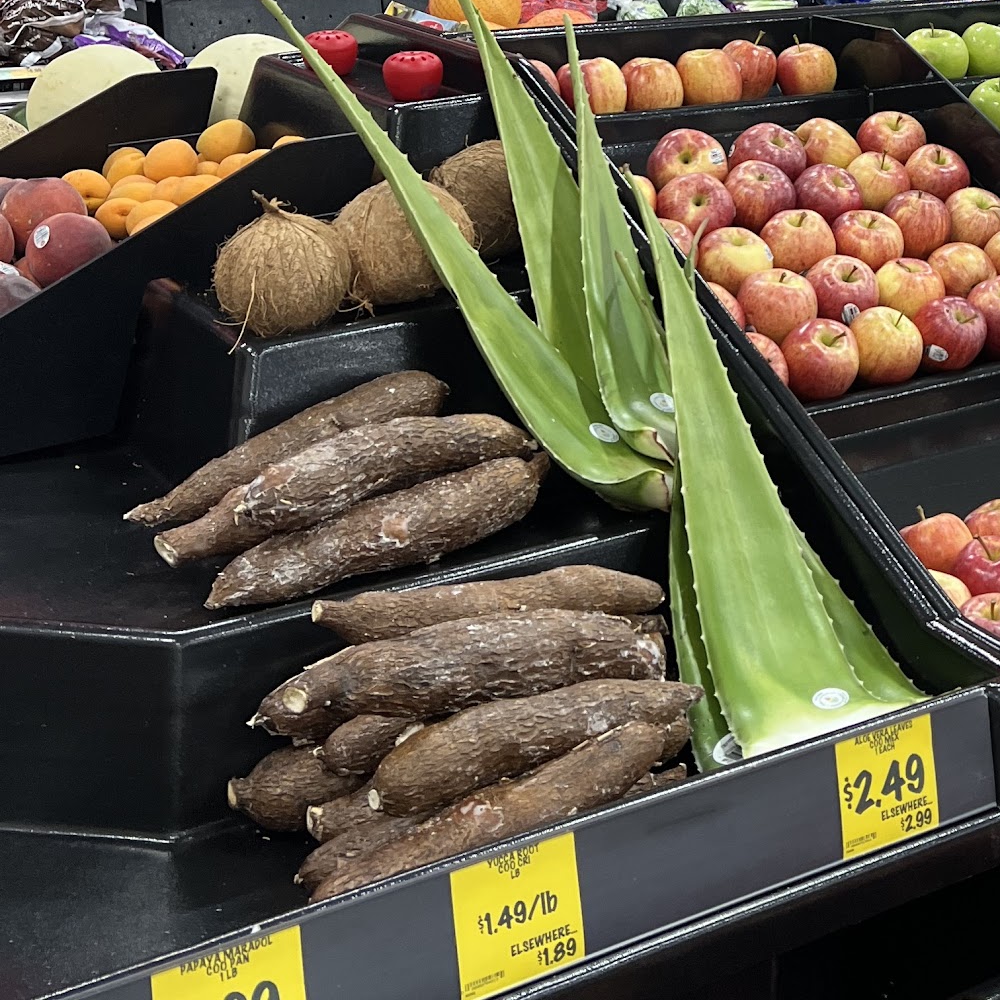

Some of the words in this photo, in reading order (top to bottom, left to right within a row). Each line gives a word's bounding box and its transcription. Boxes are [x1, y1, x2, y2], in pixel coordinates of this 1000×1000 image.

[879, 744, 895, 755] EACH
[843, 753, 925, 815] $2.49
[900, 808, 932, 833] $2.99
[487, 850, 515, 868] YUCCA
[511, 868, 520, 879] LB
[477, 890, 558, 936] $1.49/lb
[179, 953, 221, 975] PAPAYA
[224, 935, 273, 961] MARADOL
[537, 937, 577, 966] $1.89
[206, 961, 227, 976] COO
[230, 953, 250, 968] PAN
[226, 968, 238, 980] LB
